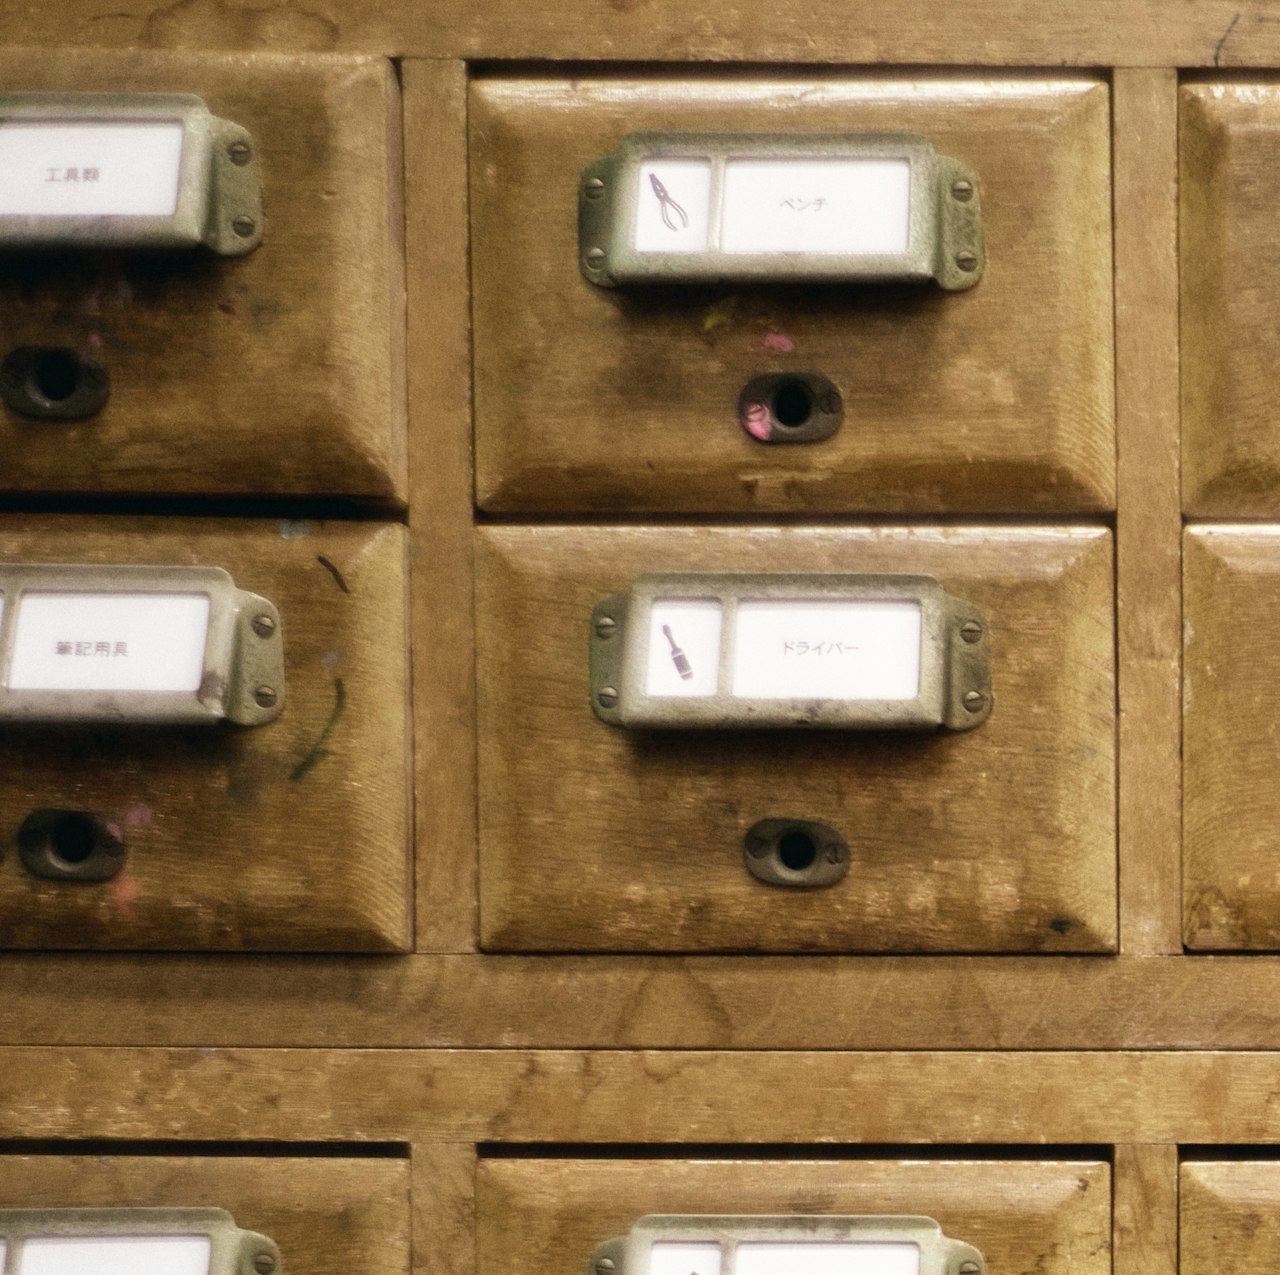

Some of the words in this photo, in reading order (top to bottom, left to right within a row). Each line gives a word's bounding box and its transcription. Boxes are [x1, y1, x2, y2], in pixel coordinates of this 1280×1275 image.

[45, 166, 101, 184] 工具類
[780, 197, 828, 213] ペンチ
[54, 640, 129, 658] 筆記用具
[783, 640, 861, 657] ドライバー
